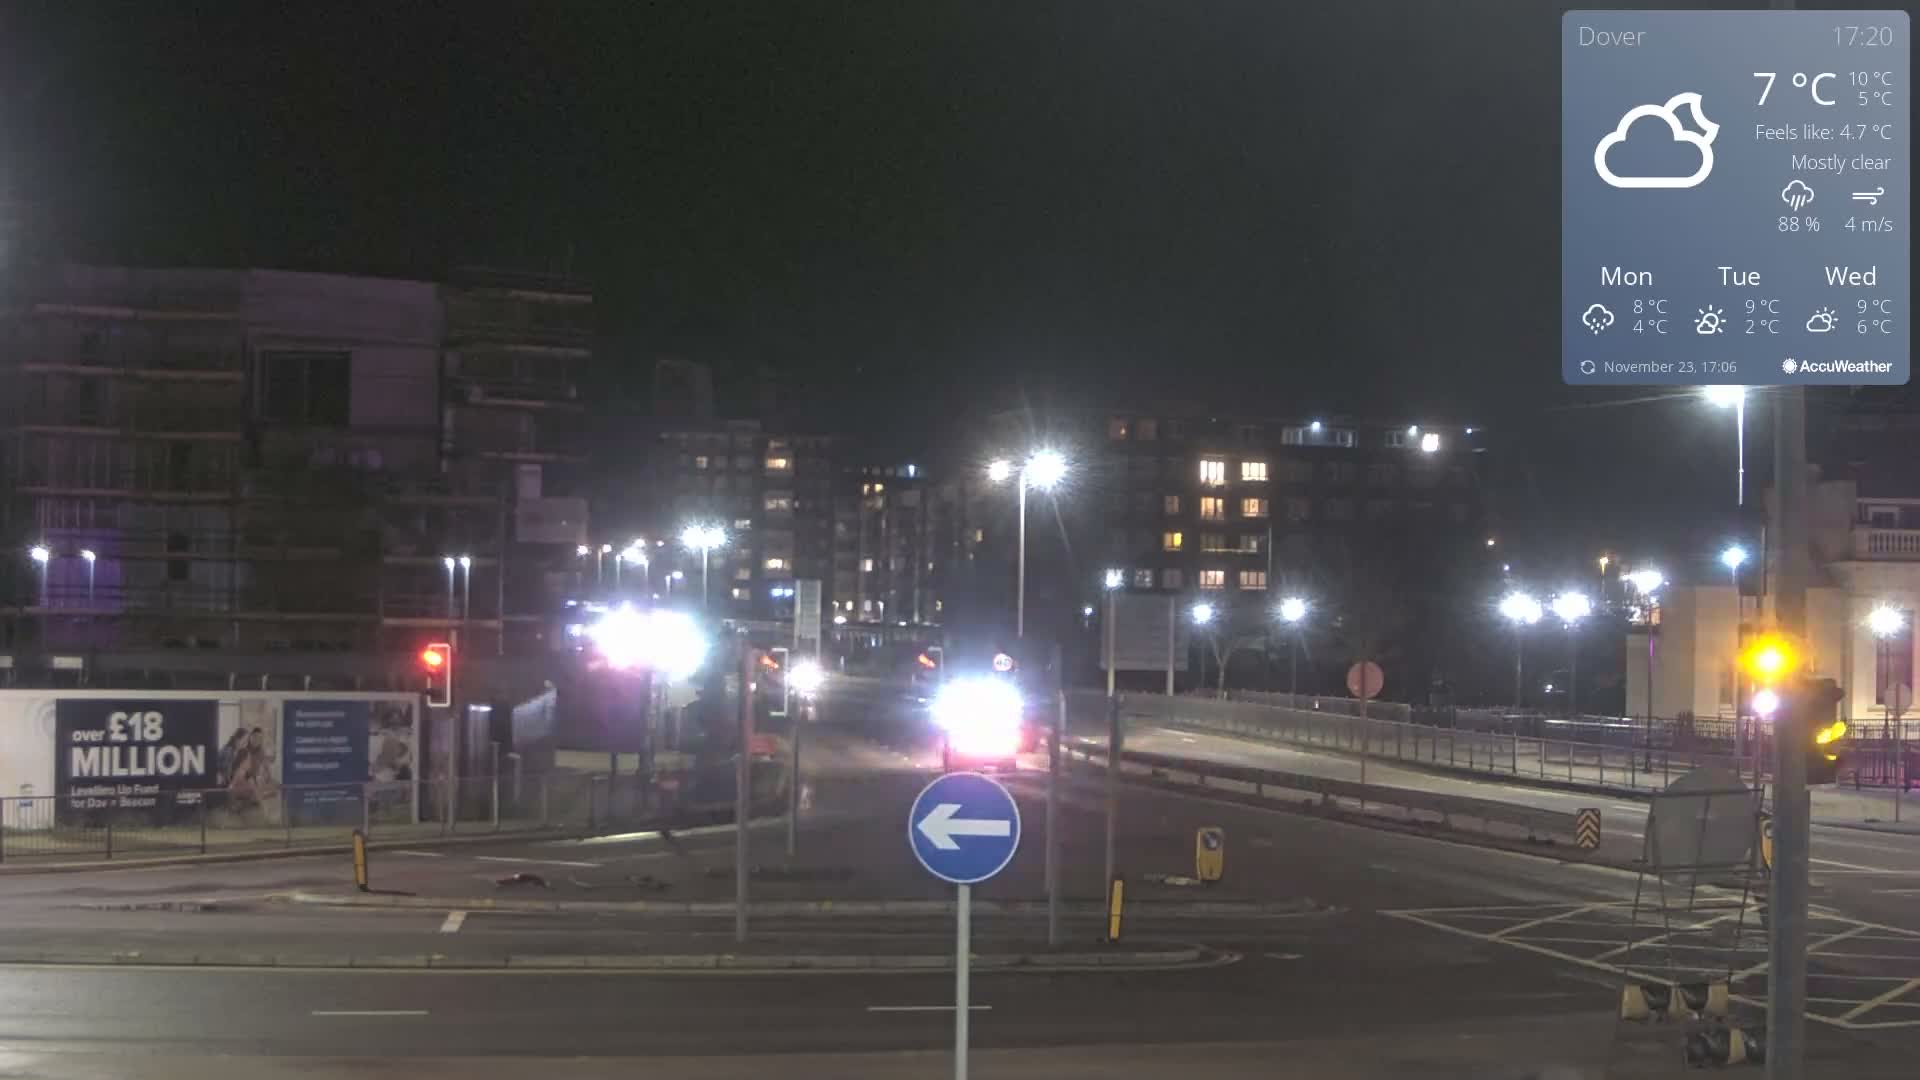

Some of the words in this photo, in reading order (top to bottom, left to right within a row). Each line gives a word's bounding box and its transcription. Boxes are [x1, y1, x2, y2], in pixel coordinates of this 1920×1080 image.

[72, 729, 105, 742] over
[109, 711, 163, 742] £18
[71, 745, 206, 777] MILLION
